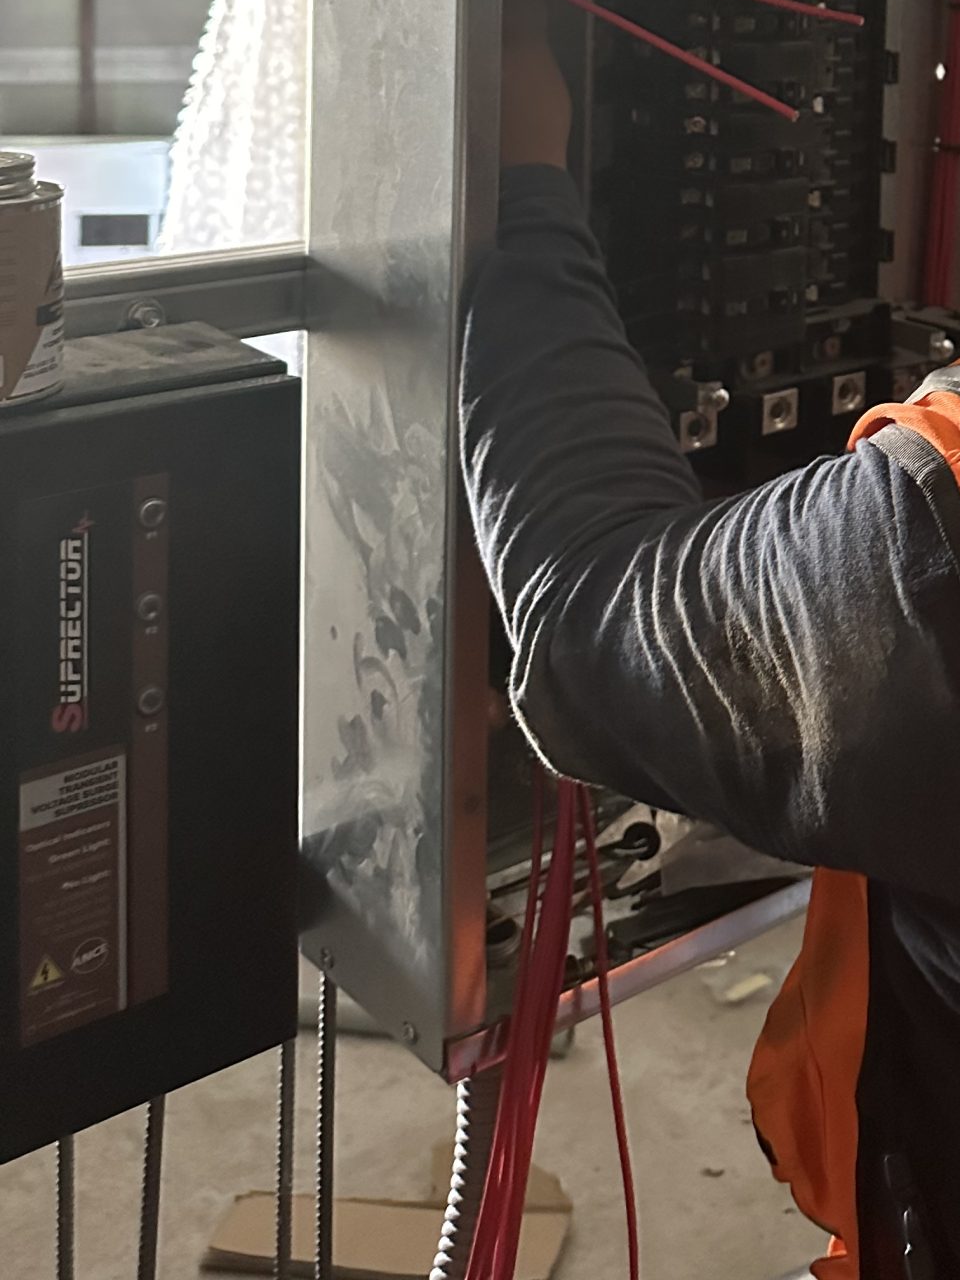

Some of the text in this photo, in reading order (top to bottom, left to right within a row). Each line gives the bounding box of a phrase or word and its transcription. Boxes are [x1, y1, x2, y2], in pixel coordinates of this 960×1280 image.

[50, 538, 85, 733] SUPRECTOR
[58, 770, 118, 795] TRANSIENT
[64, 760, 118, 783] MODULAR
[31, 780, 118, 814] VOLTAGE SURGE
[48, 848, 81, 864] Green
